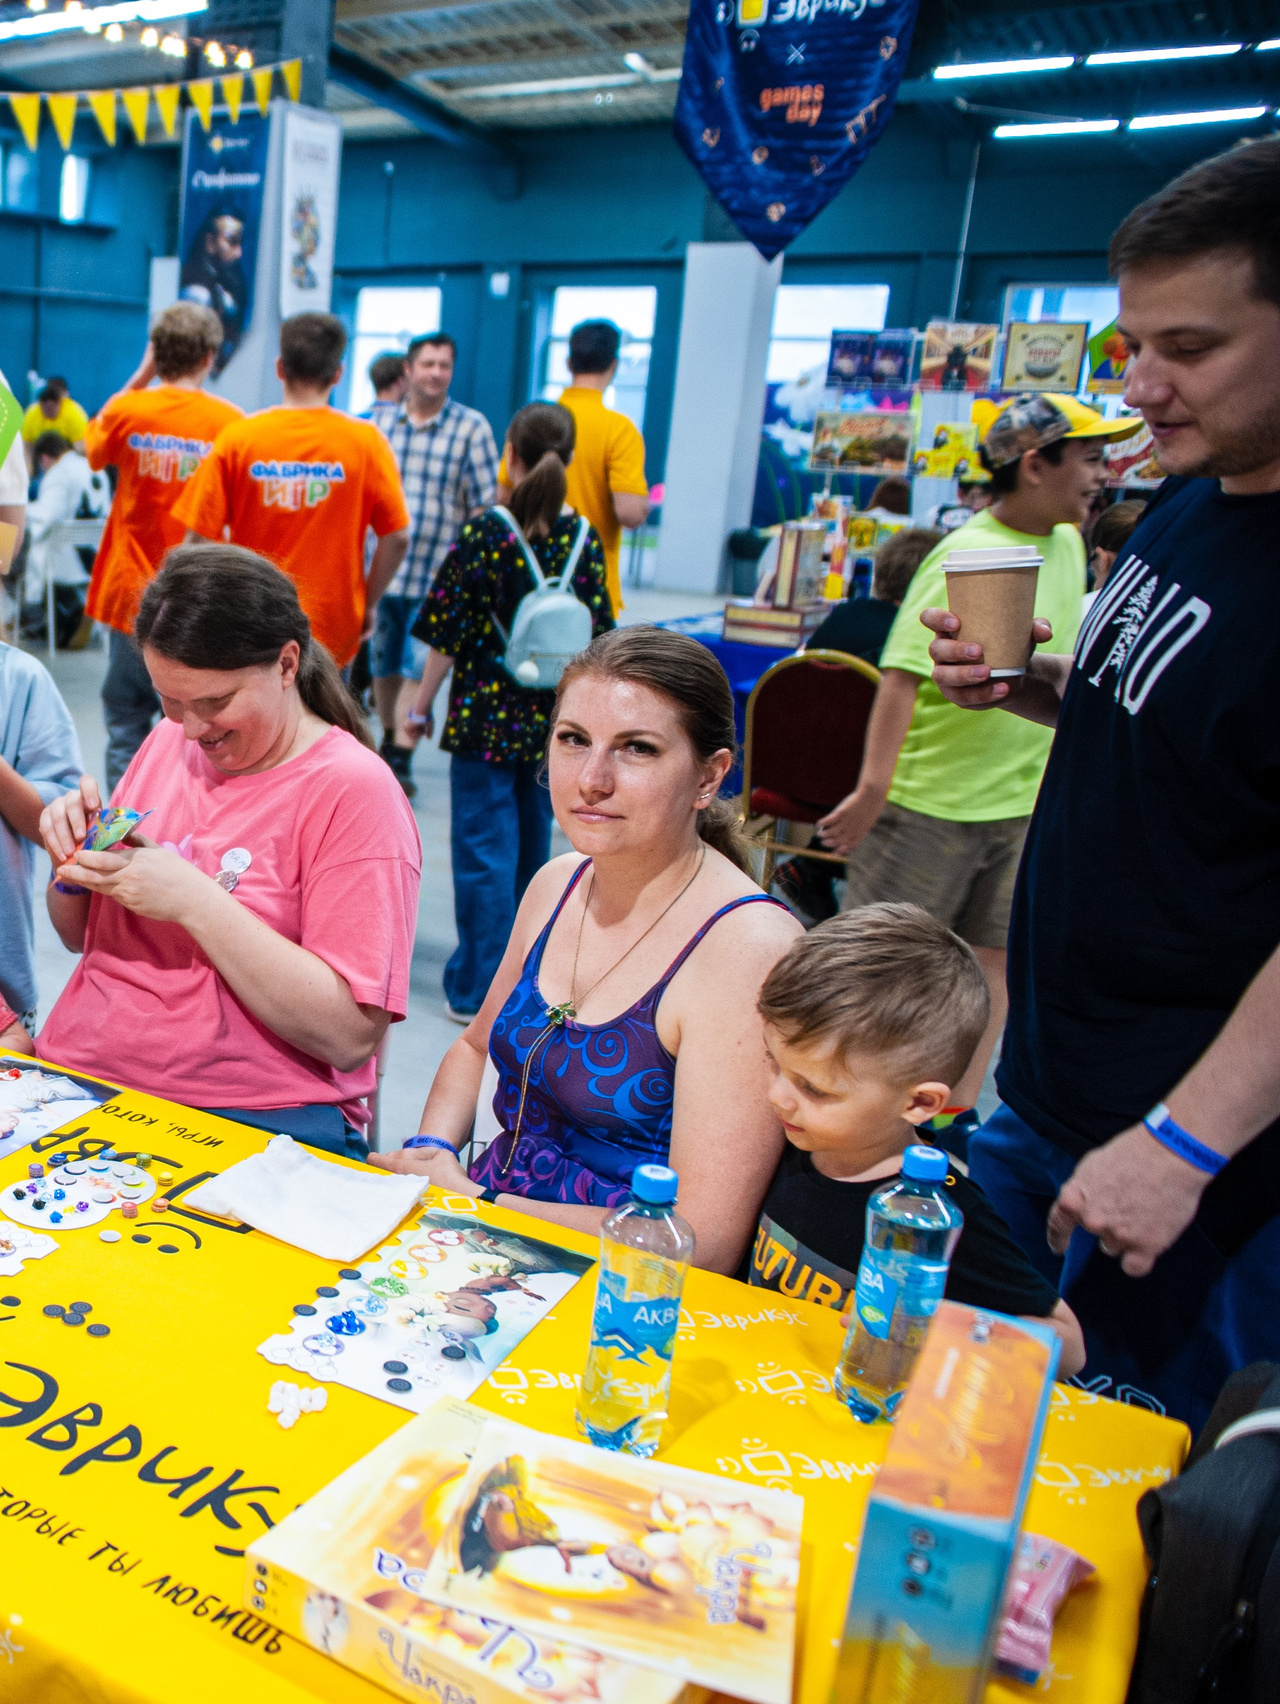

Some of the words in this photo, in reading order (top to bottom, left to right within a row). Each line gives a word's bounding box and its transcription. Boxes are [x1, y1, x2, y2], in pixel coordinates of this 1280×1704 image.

[759, 83, 825, 113] games
[786, 103, 822, 127] day
[137, 450, 201, 484] ИГР
[249, 460, 345, 482] ФАБРИКА
[263, 479, 330, 511] ИГР
[753, 1226, 856, 1314] UTUR
[633, 1305, 678, 1327] АКВ
[88, 1541, 143, 1577] ТЫ
[141, 1575, 283, 1654] ЛЮБИШЬ
